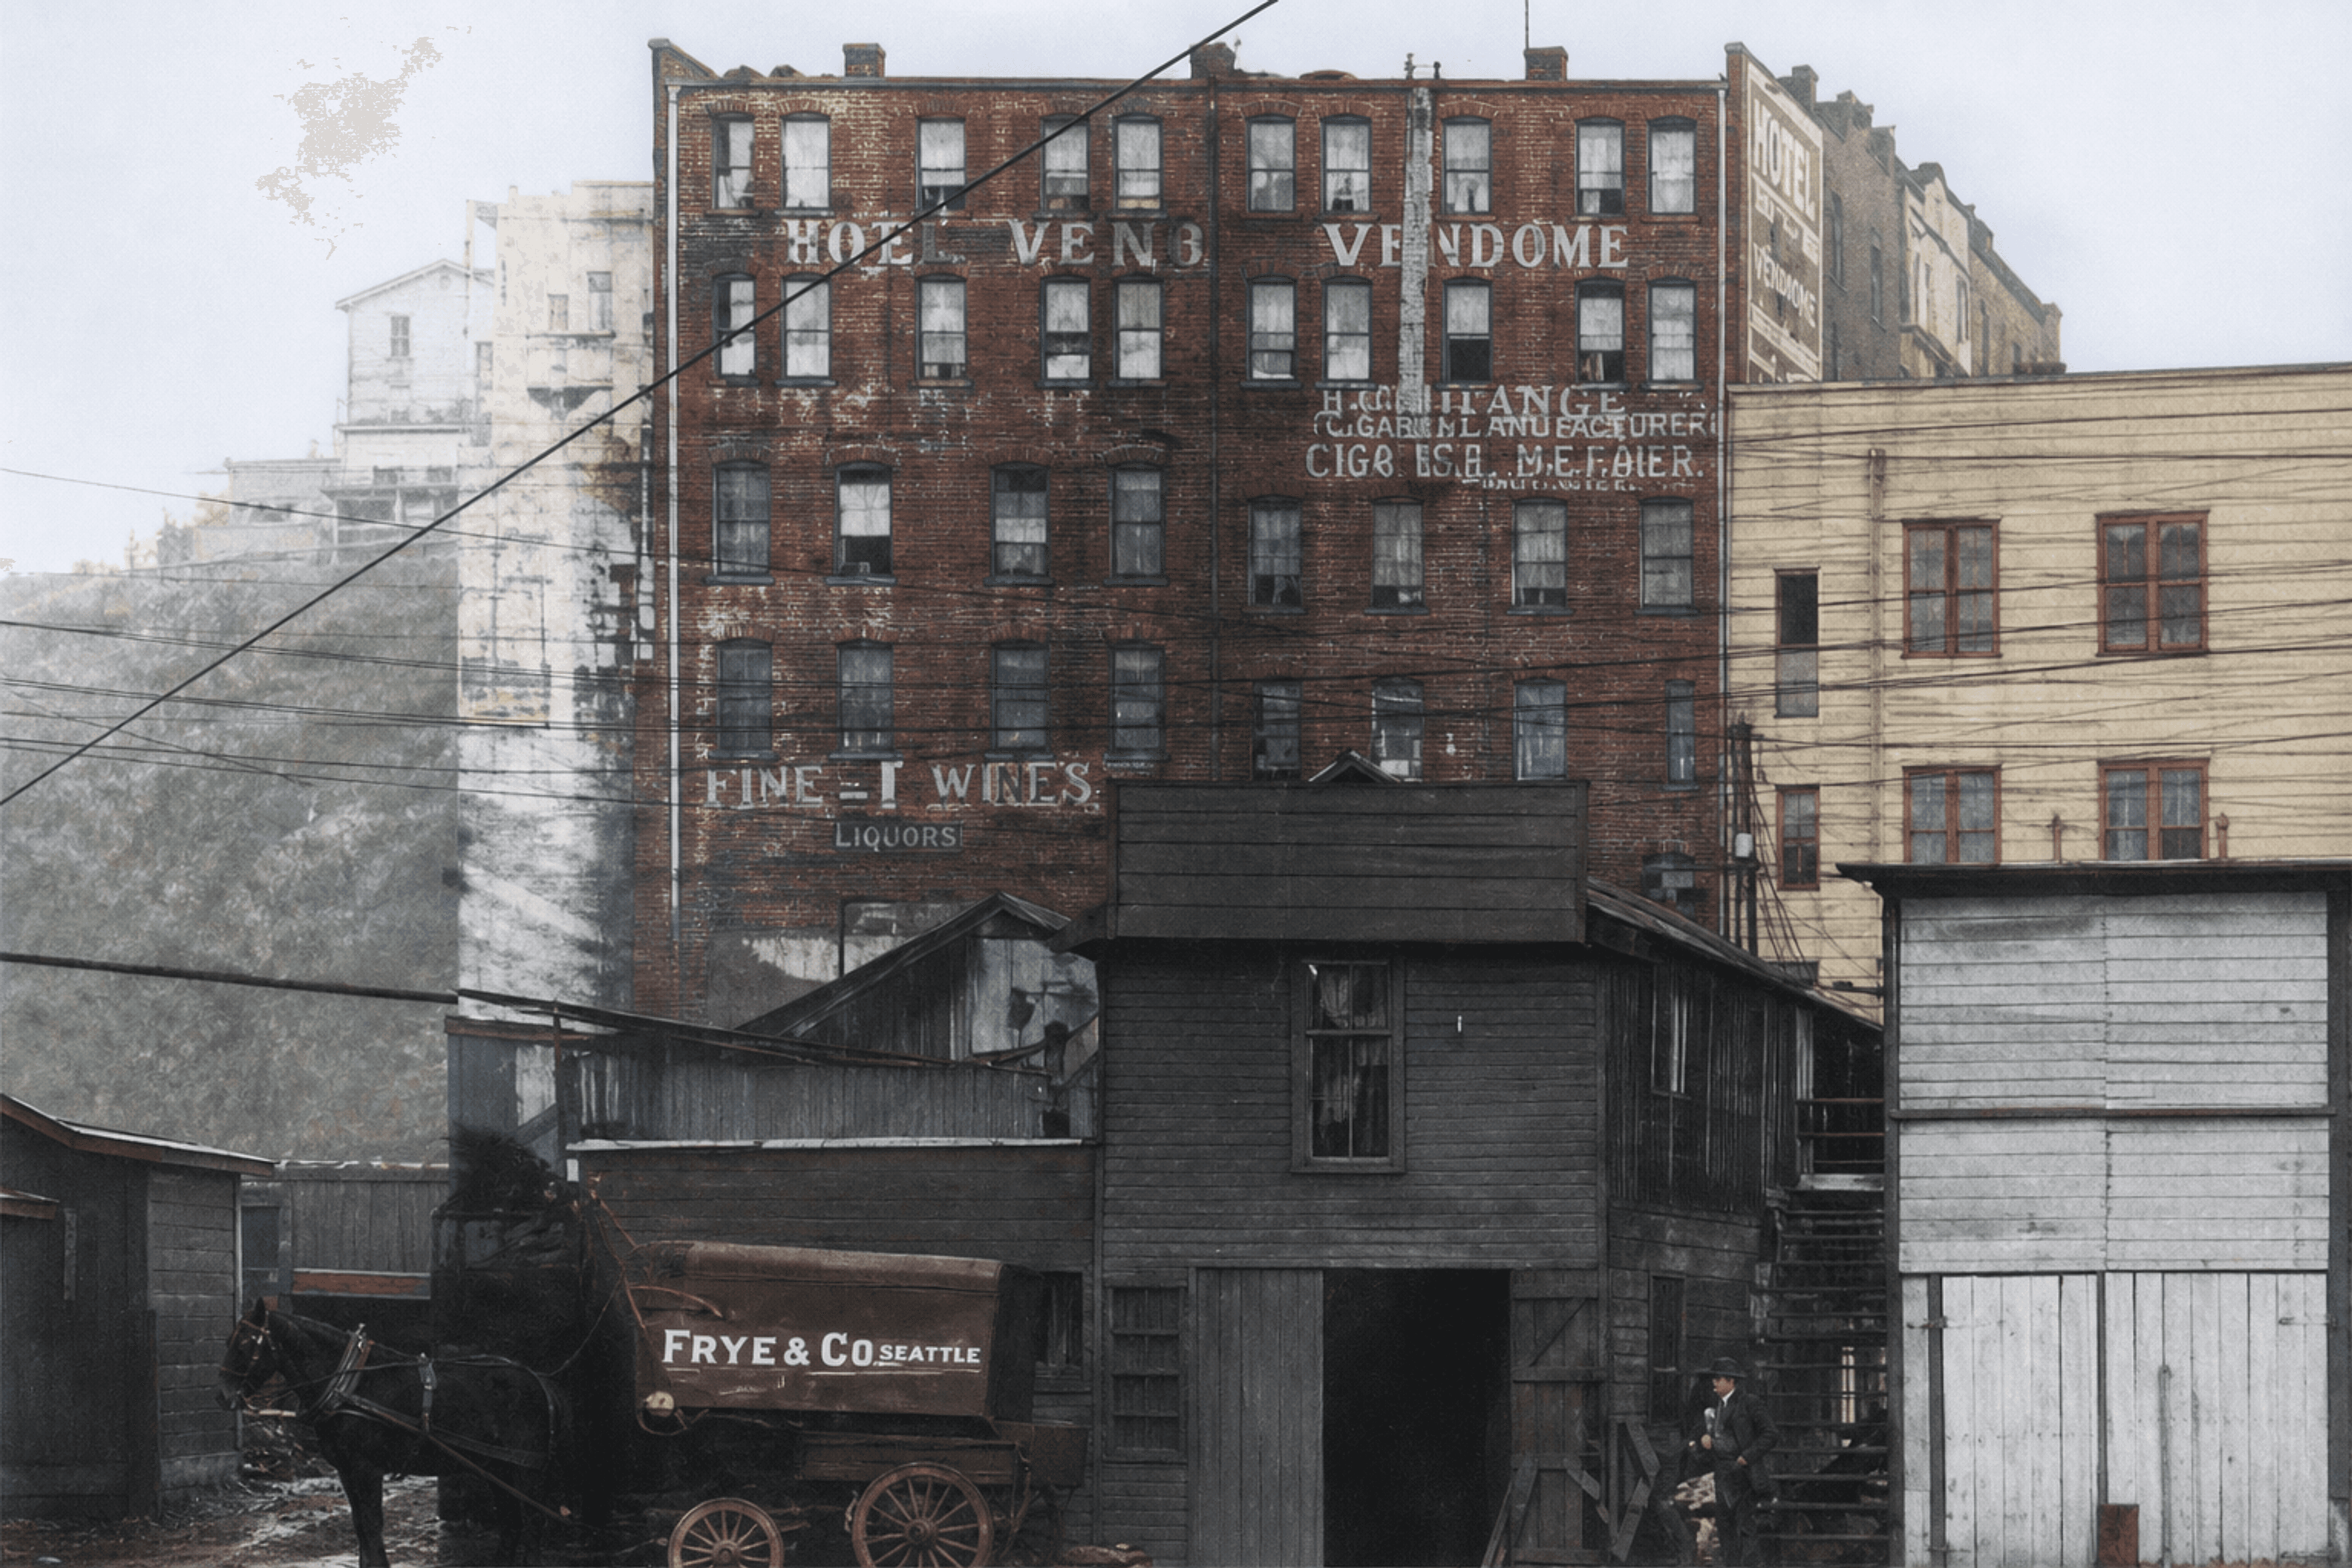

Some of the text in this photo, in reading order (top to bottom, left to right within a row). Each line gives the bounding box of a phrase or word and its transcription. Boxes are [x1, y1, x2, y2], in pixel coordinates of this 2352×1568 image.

[1753, 98, 1815, 222] HOTEL
[703, 765, 823, 810] FINE
[931, 762, 1092, 807] WINES
[835, 823, 957, 852] LIQUORS
[662, 1329, 777, 1365] FRYE
[783, 1337, 811, 1366] &
[879, 1344, 981, 1363] SEATTLE
